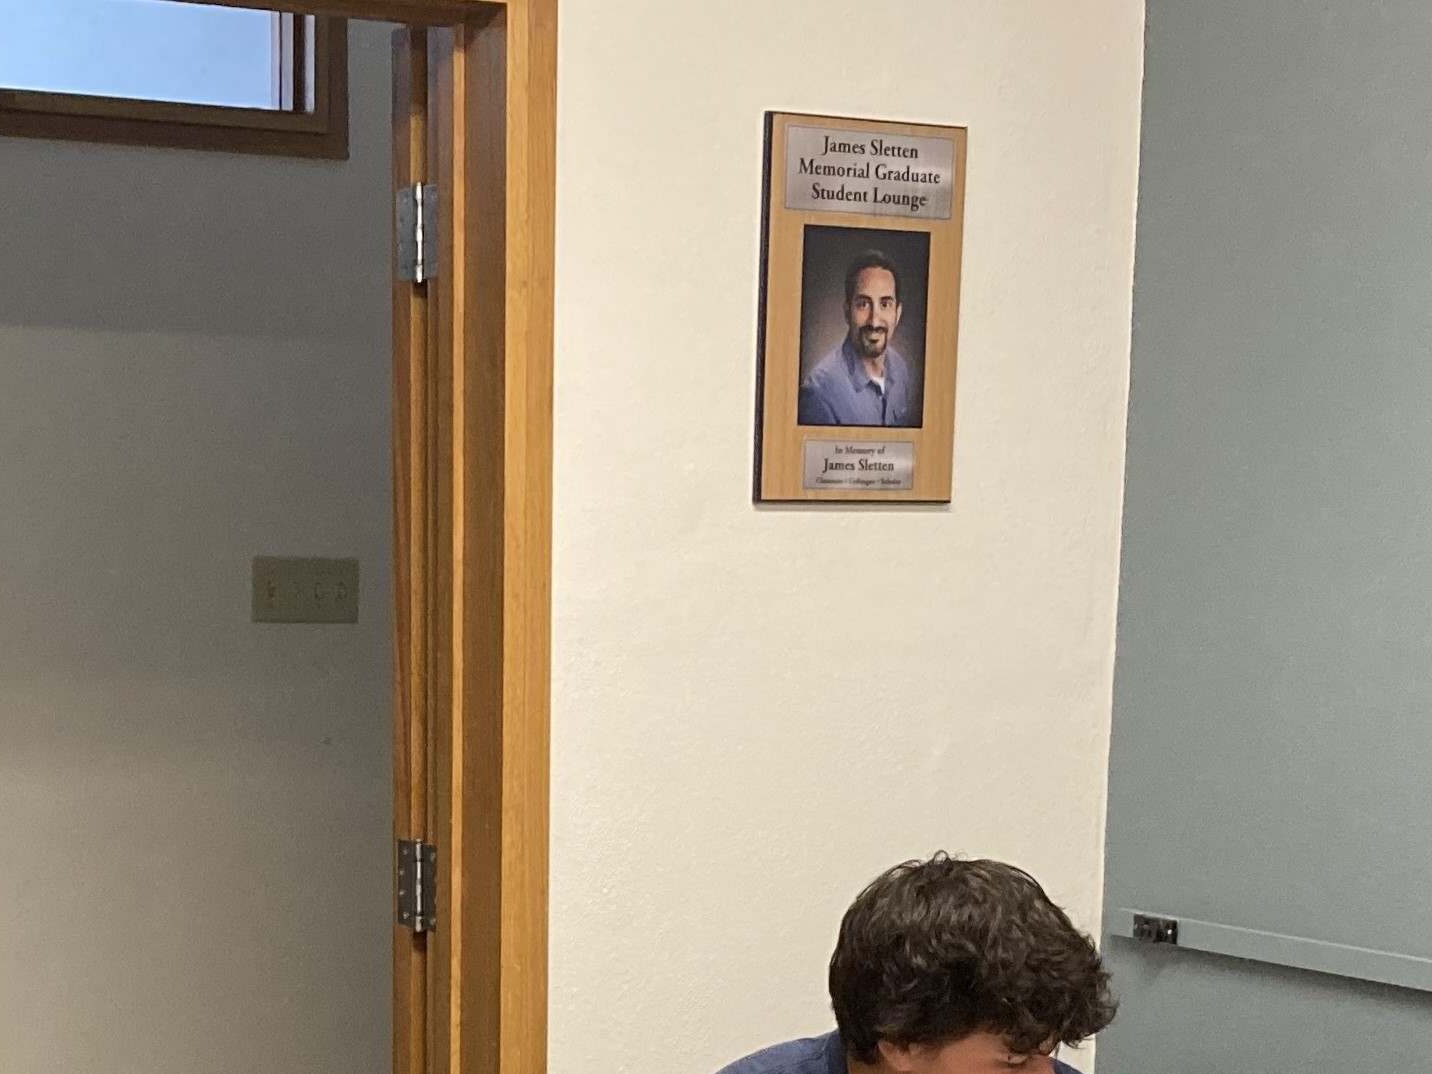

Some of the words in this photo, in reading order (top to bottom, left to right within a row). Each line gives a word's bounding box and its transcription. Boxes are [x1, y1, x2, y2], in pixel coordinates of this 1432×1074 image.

[821, 135, 866, 156] James
[870, 139, 919, 159] Sletten
[798, 157, 870, 179] Memorial
[875, 163, 941, 184] Graduate
[811, 182, 868, 202] Student
[873, 186, 928, 211] Lounge
[834, 446, 843, 455] In
[845, 446, 875, 457] Memory
[877, 446, 886, 454] of
[822, 458, 856, 473] James
[858, 459, 895, 471] Sletten
